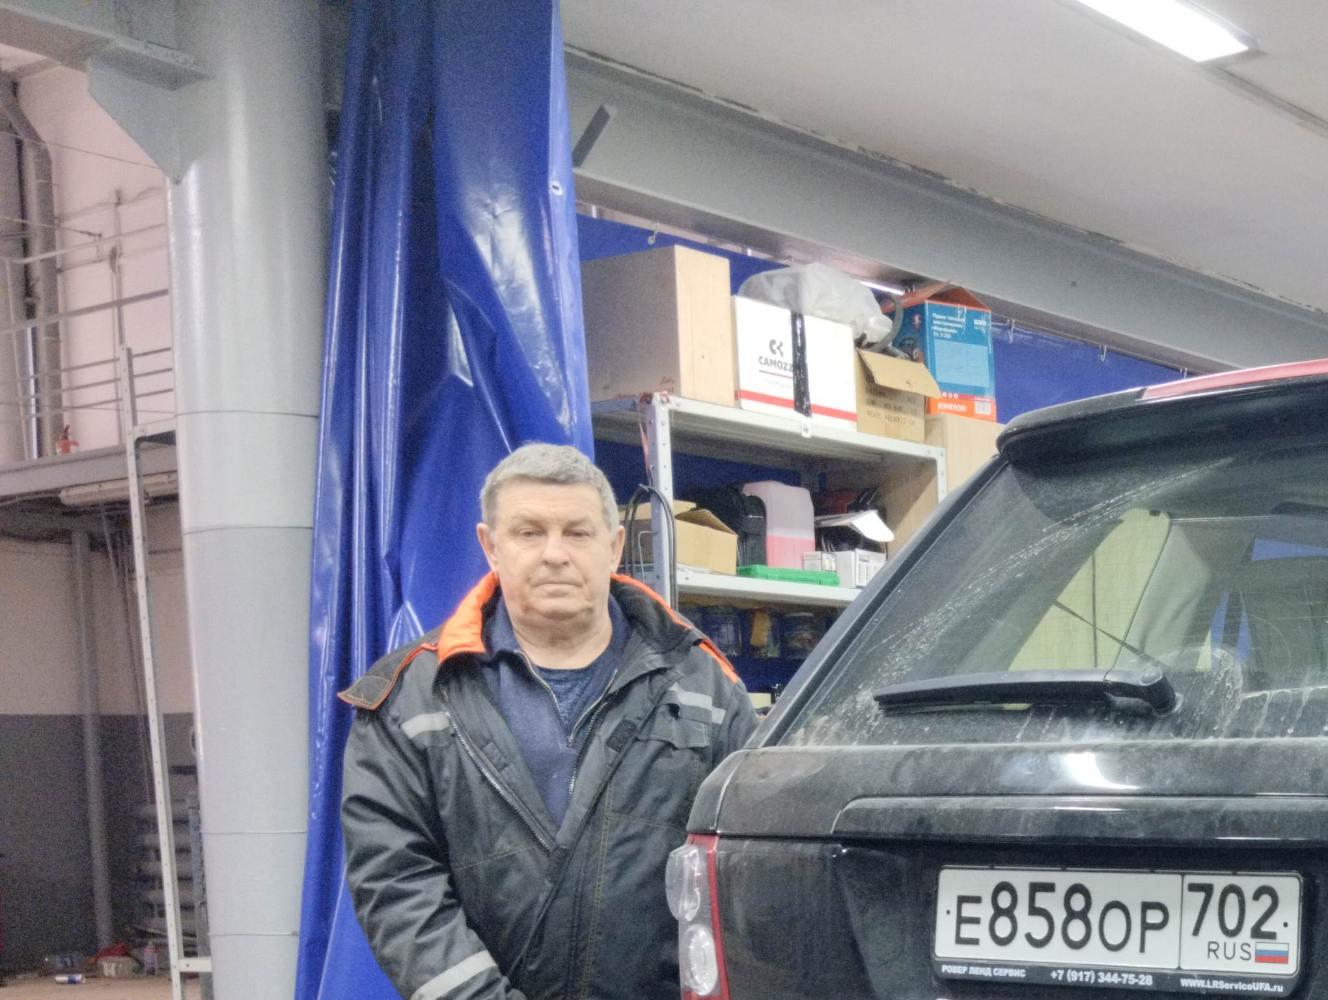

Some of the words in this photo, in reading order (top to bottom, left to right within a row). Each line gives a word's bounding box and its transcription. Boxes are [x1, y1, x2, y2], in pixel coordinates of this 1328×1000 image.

[758, 355, 795, 373] CAMOZZ
[954, 881, 1170, 953] Е858ОР
[1187, 883, 1280, 940] 702
[1207, 941, 1252, 961] RUS
[1050, 969, 1065, 981] +7
[1066, 968, 1096, 984] (917)
[1097, 971, 1153, 986] 344-75-28
